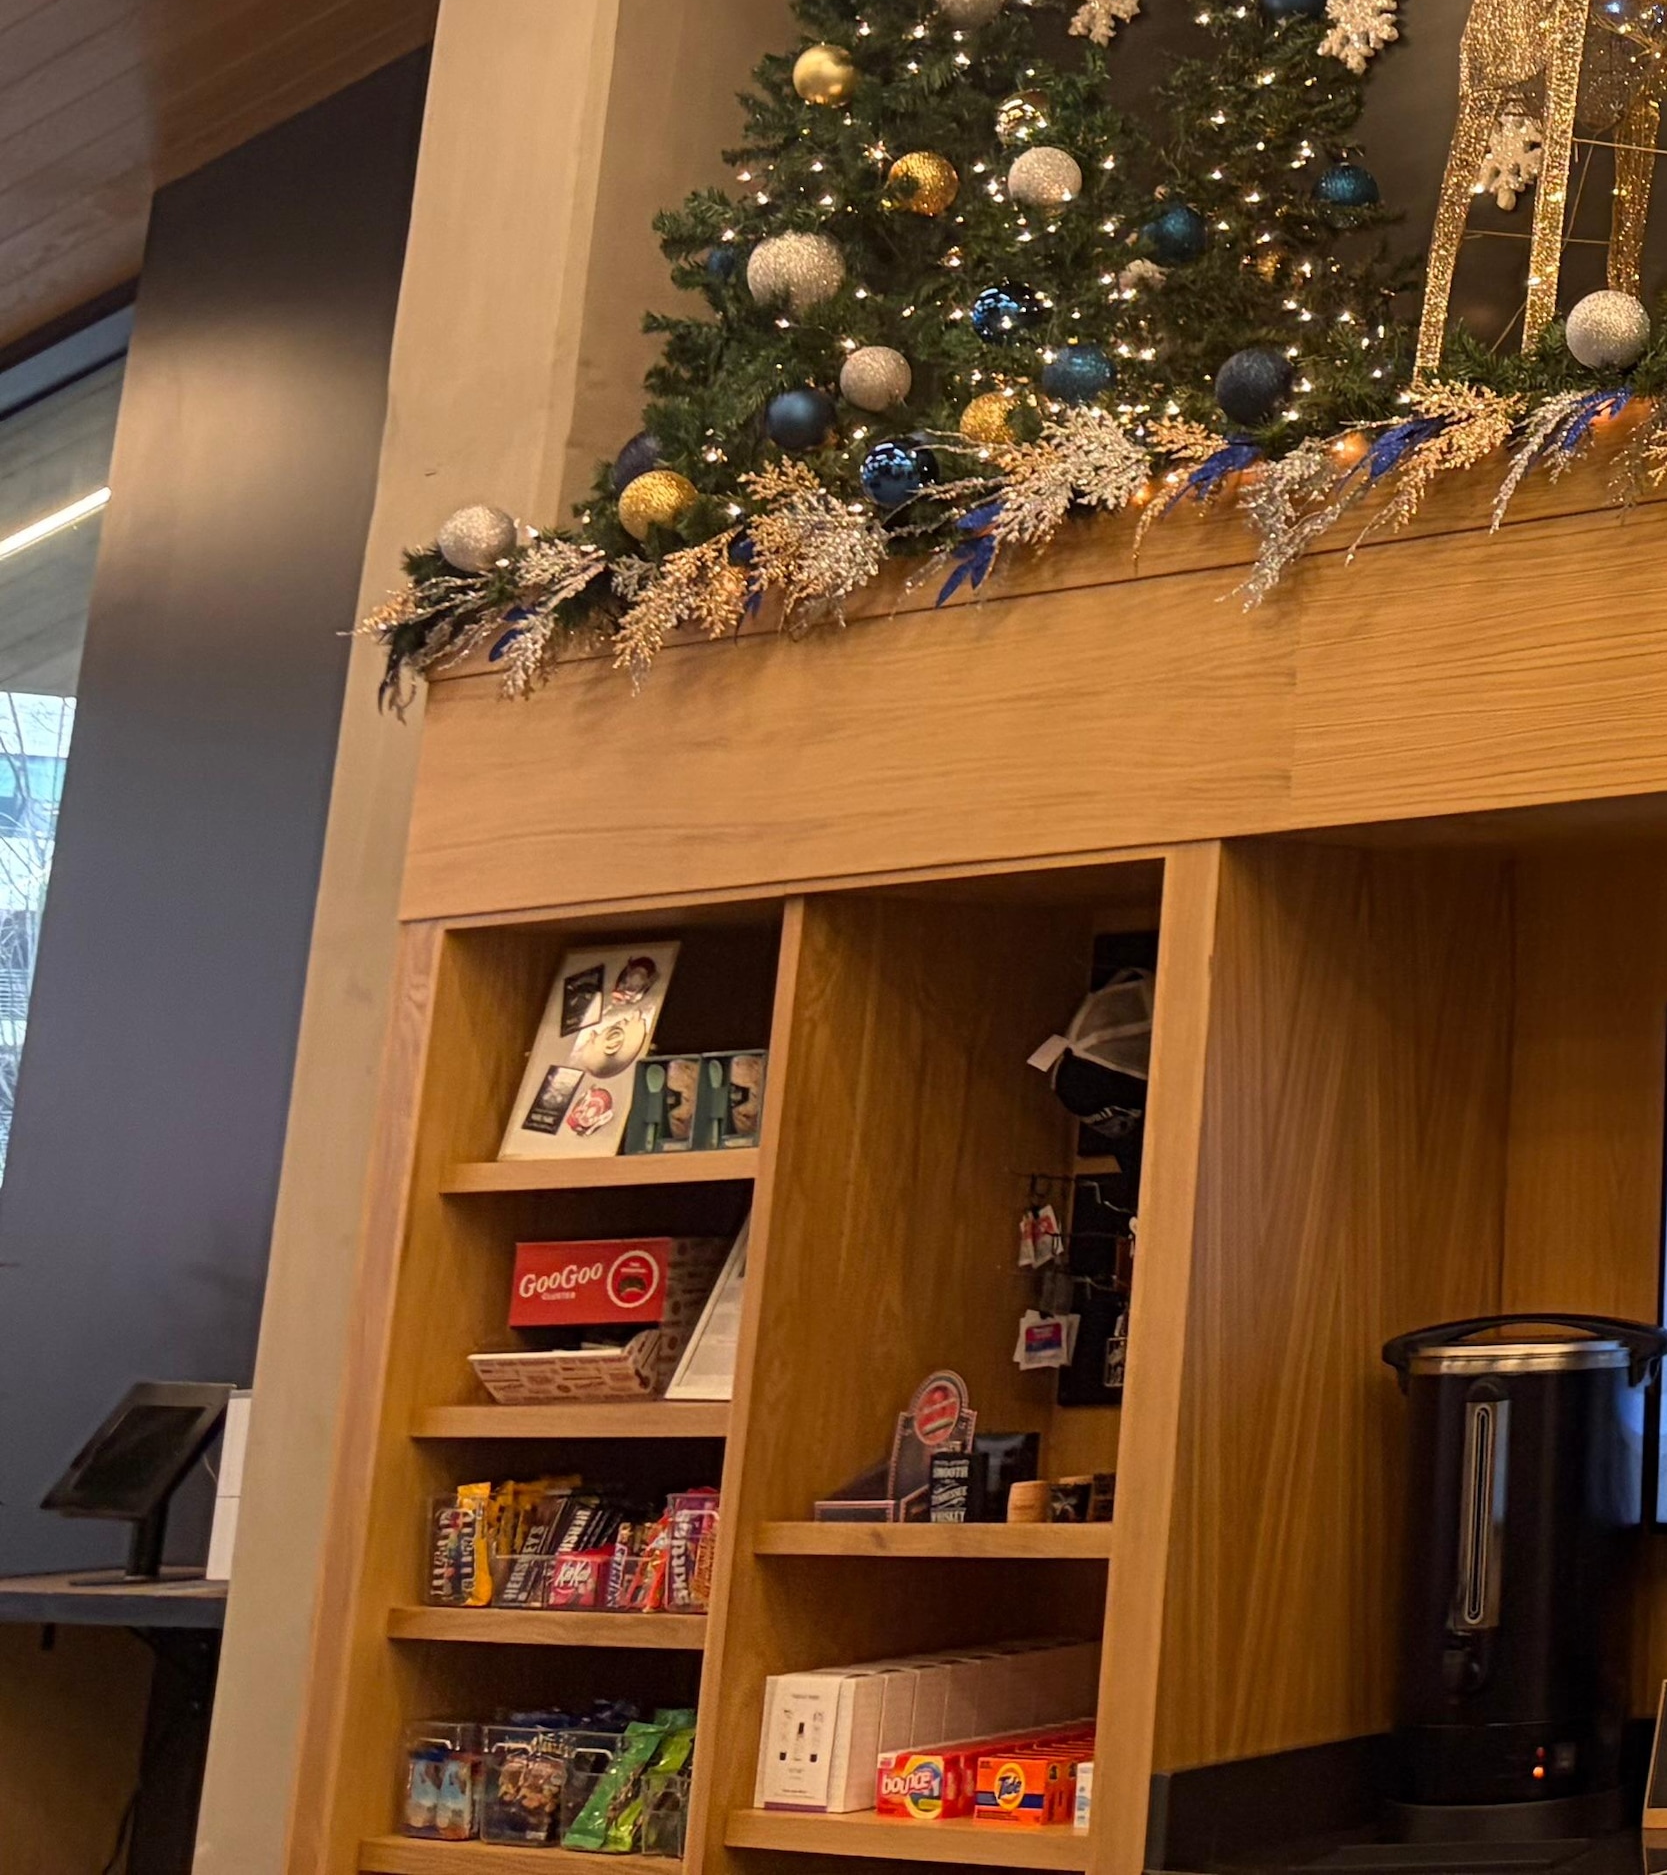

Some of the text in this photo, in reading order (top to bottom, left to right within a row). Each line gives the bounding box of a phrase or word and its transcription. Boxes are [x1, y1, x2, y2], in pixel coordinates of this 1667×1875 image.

[518, 1262, 604, 1299] GooGoo
[881, 1770, 933, 1796] bounce
[996, 1775, 1023, 1800] Tide
